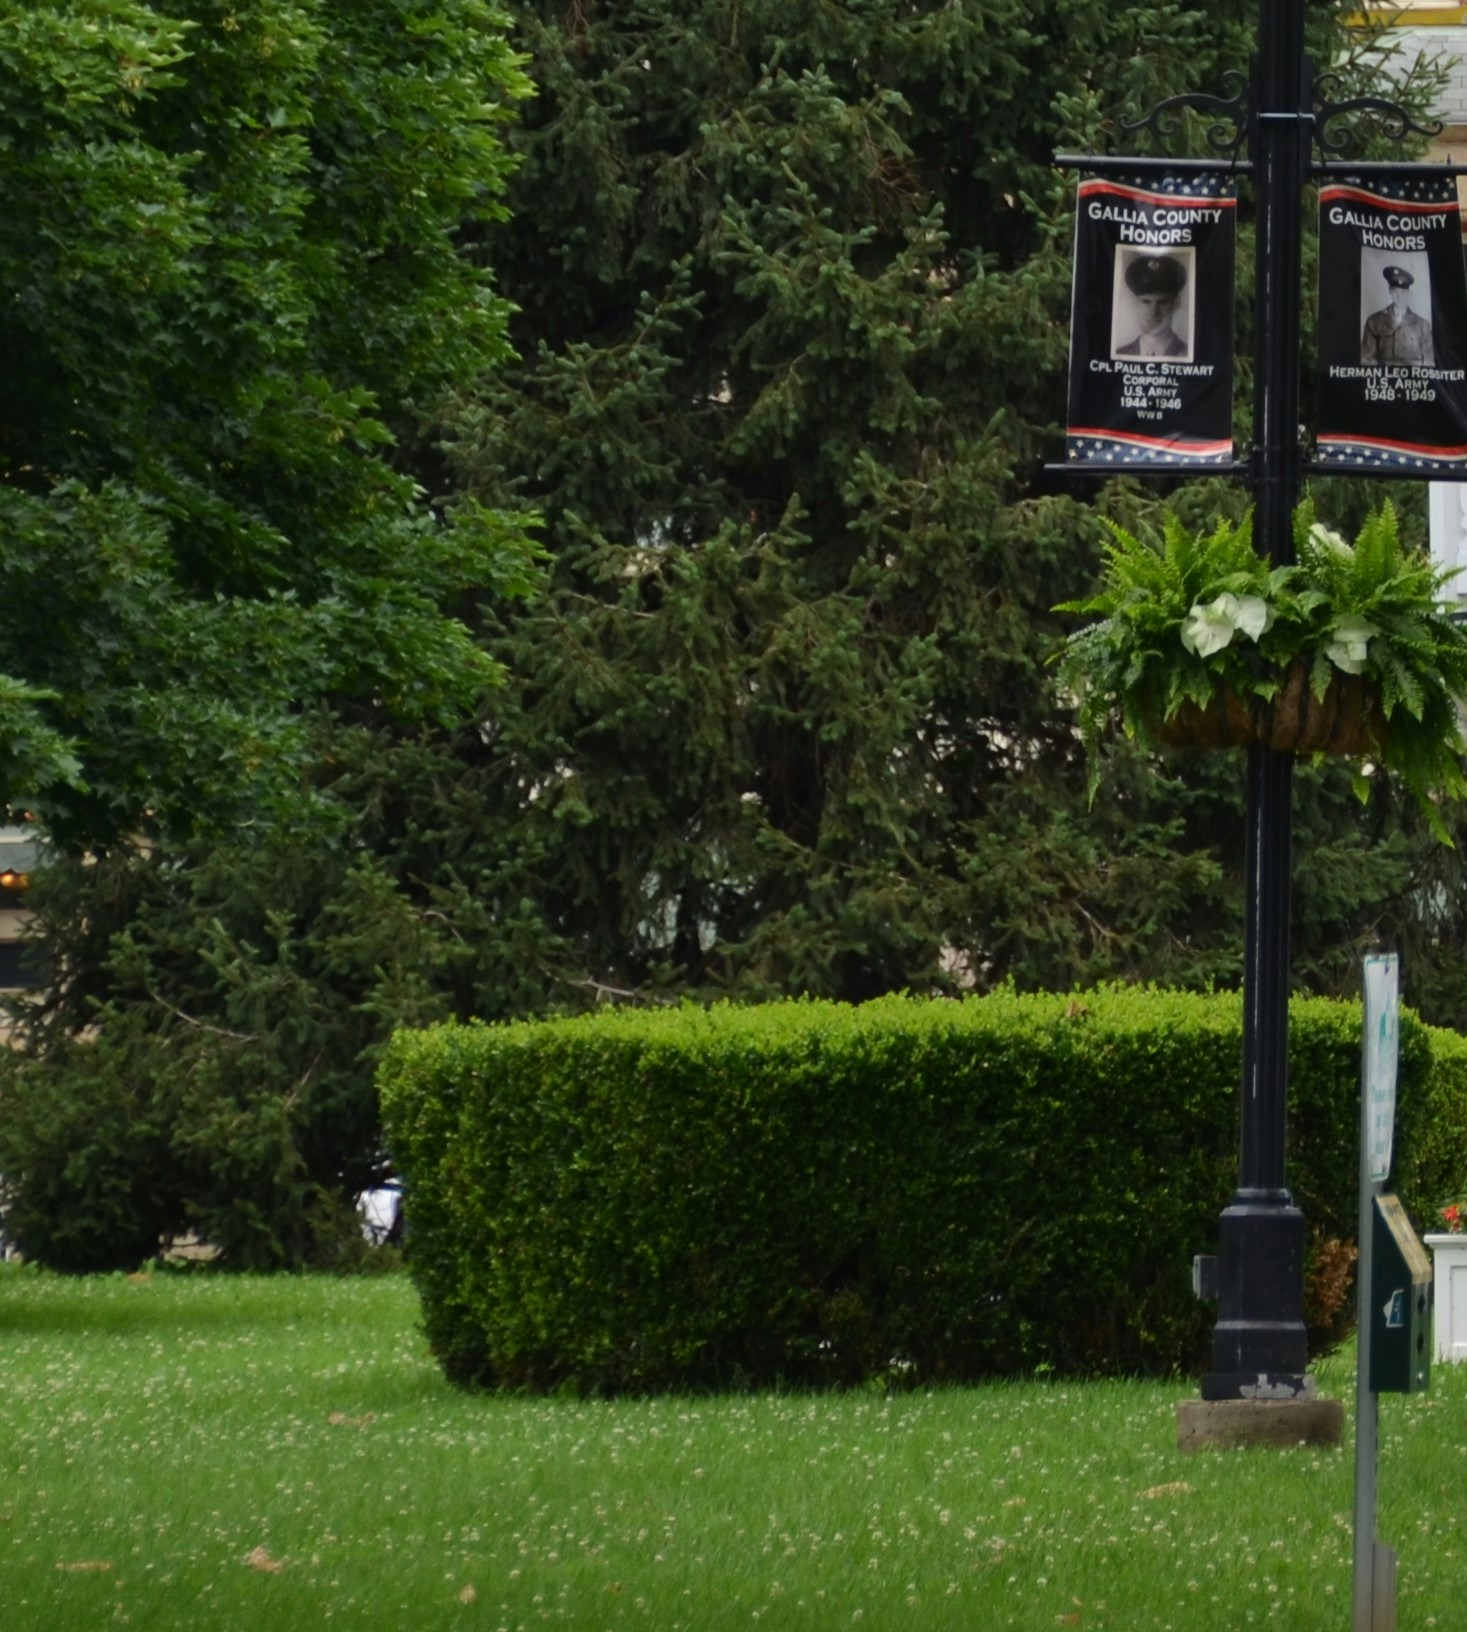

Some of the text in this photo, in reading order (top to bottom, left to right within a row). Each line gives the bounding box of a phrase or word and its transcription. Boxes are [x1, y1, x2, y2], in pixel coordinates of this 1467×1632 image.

[1087, 201, 1223, 227] GALLIA COUNTY
[1328, 206, 1448, 232] GALLIA COUNTY
[1119, 223, 1193, 245] HONORS
[1361, 228, 1426, 251] HONORS
[1089, 359, 1113, 373] CPL
[1114, 361, 1144, 375] PAUL
[1160, 363, 1215, 377] STEWART
[1328, 364, 1466, 381] HERMAN LEO ROSSITER
[1122, 374, 1179, 387] CORPORAL
[1366, 376, 1429, 390] U.S. ARMY
[1123, 385, 1178, 398] U.S. ARMY
[1363, 388, 1395, 402] 1948
[1404, 389, 1437, 403] 1949
[1119, 396, 1148, 409] 1944
[1155, 398, 1182, 410] 1946
